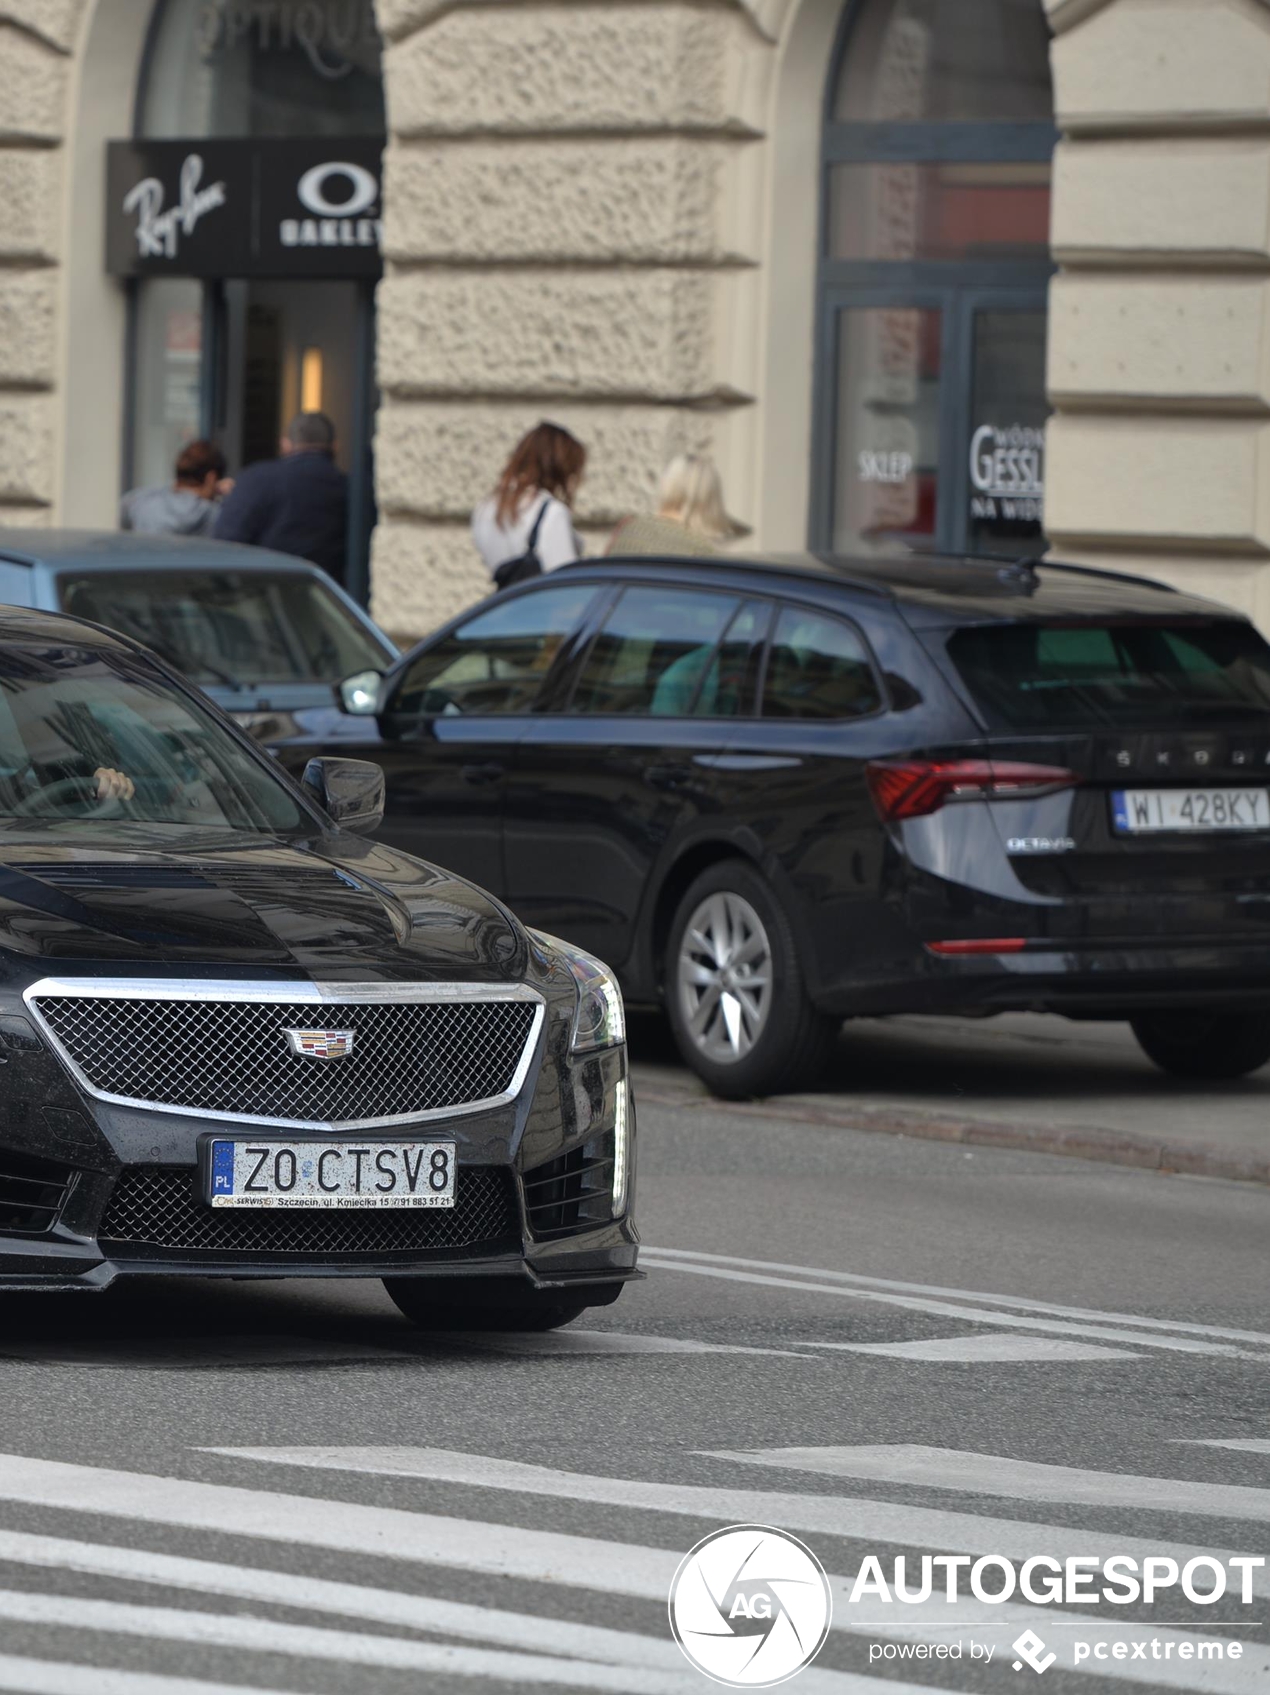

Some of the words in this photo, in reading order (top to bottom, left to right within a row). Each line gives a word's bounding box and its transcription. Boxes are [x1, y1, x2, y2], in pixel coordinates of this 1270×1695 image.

[858, 450, 913, 483] SKLEP
[971, 497, 997, 519] NA
[1133, 793, 1164, 825] WI
[1180, 793, 1259, 824] 428KY
[215, 1175, 230, 1188] PL
[317, 1148, 449, 1192] CTSV8
